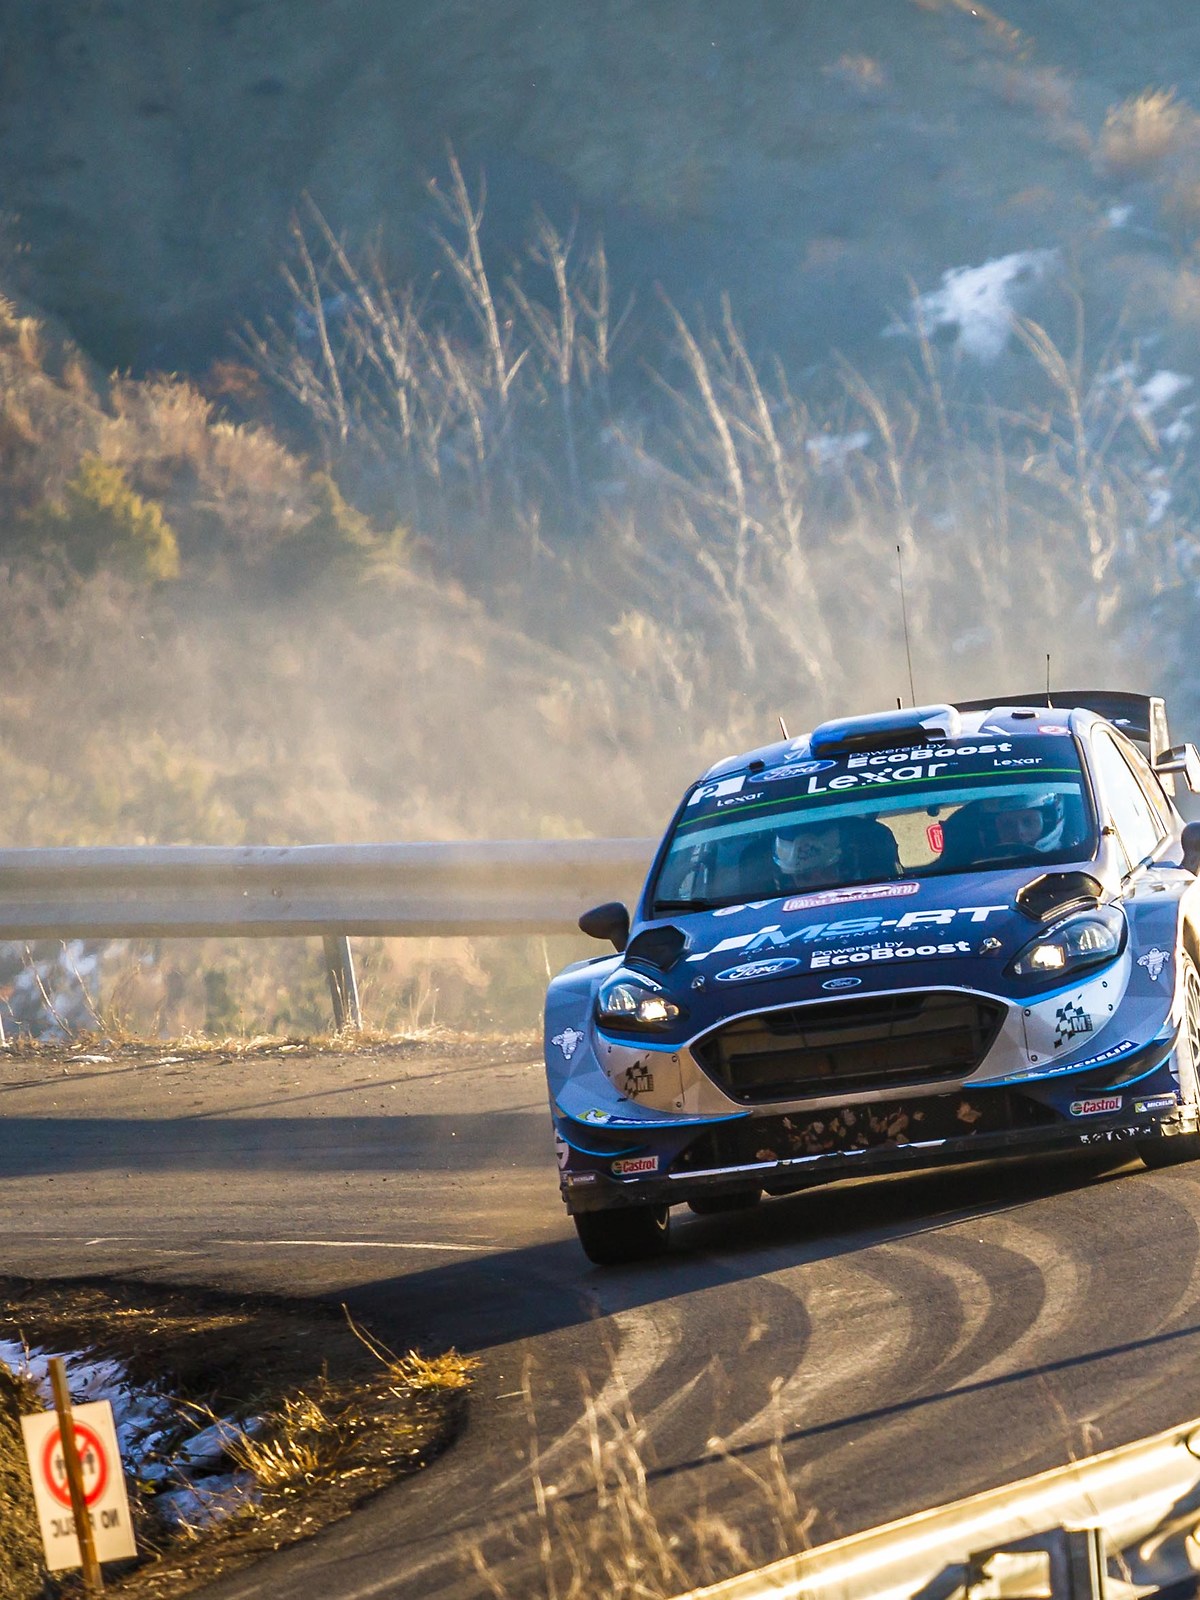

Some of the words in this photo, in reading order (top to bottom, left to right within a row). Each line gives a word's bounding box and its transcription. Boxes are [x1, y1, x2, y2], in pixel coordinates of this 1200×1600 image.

[847, 742, 1013, 769] EcoBoost
[849, 743, 921, 758] Powered
[926, 742, 946, 751] by
[993, 757, 1043, 767] Lexar
[763, 762, 823, 781] Ford
[807, 762, 949, 794] Lexar
[716, 792, 765, 807] Lexar
[744, 905, 1009, 951] MS-RT
[809, 940, 971, 969] EcoBoost
[811, 942, 881, 957] Powered
[885, 940, 904, 950] by
[727, 961, 783, 979] Ford
[1083, 1099, 1120, 1113] Castrol
[622, 1159, 656, 1173] Castrol
